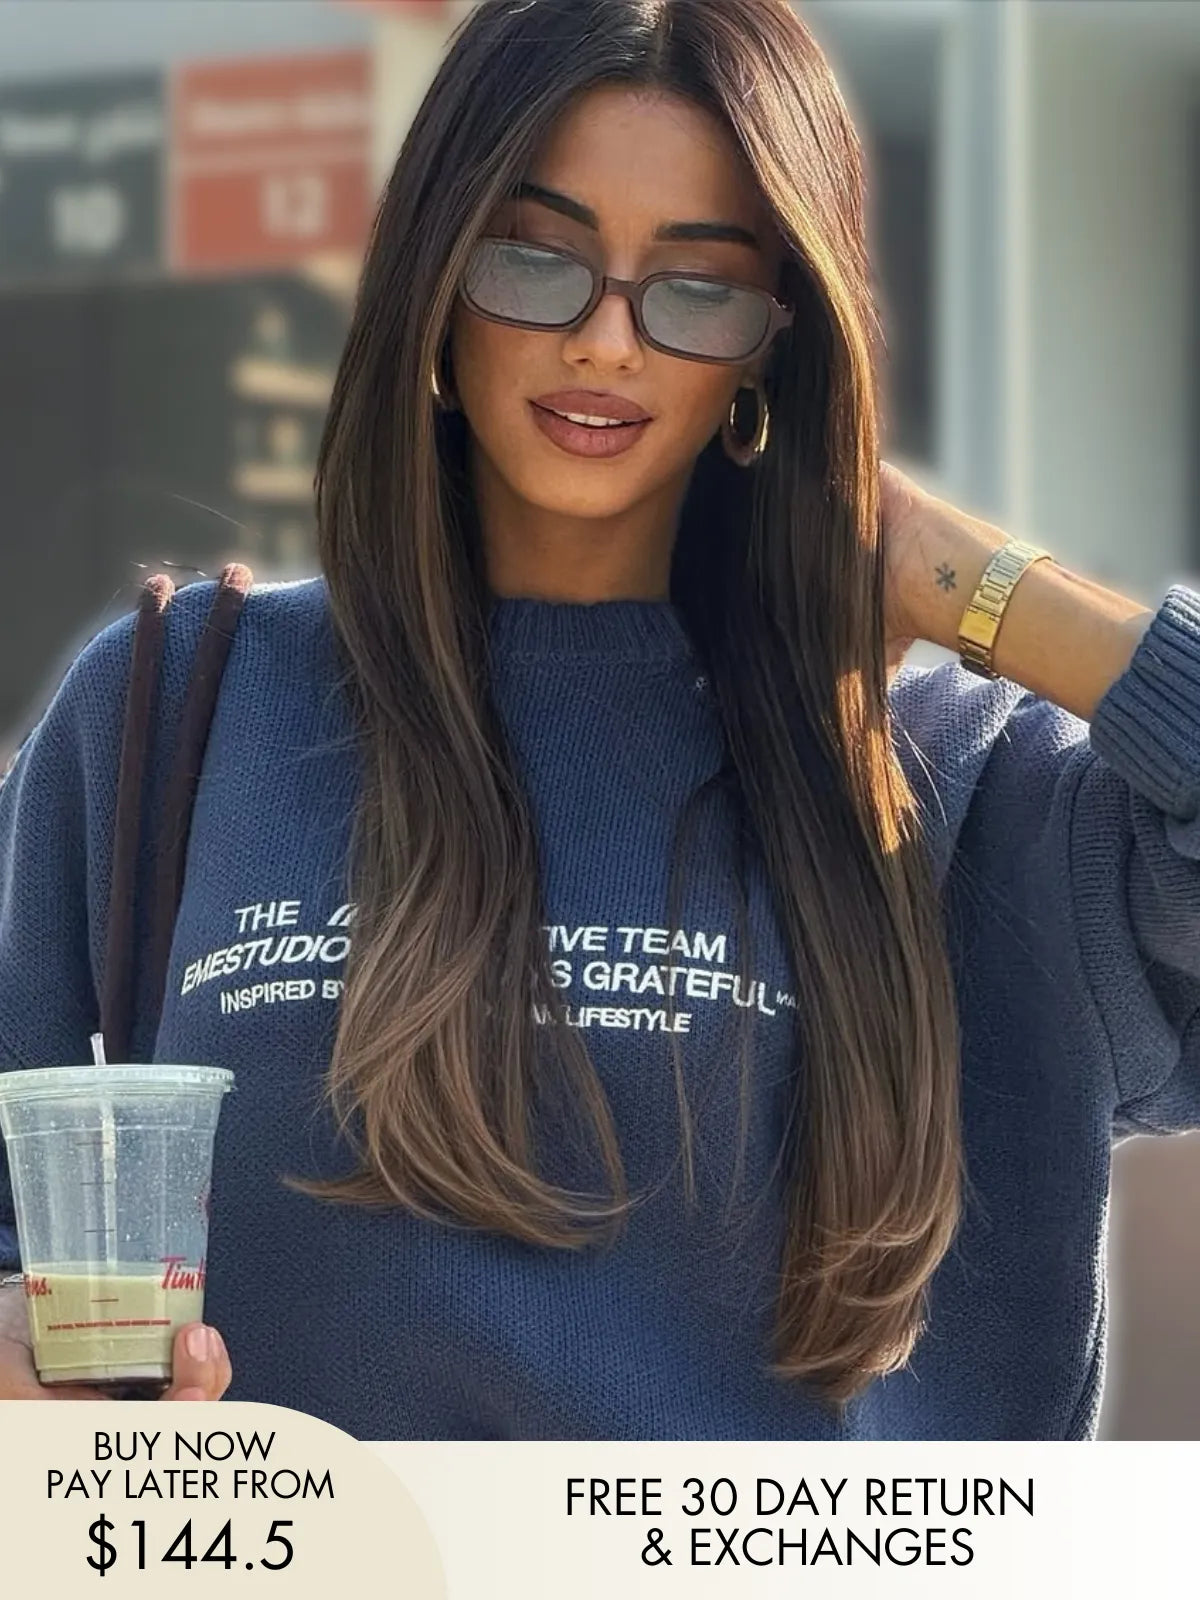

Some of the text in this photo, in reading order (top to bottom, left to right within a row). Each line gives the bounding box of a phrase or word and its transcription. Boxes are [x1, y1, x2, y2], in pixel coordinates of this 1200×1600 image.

[234, 900, 301, 933] THE
[616, 926, 728, 964] TEAM
[220, 979, 316, 1014] INSPIRED
[565, 1003, 692, 1033] LIFESTYLE
[582, 961, 777, 1016] GRATEFUL
